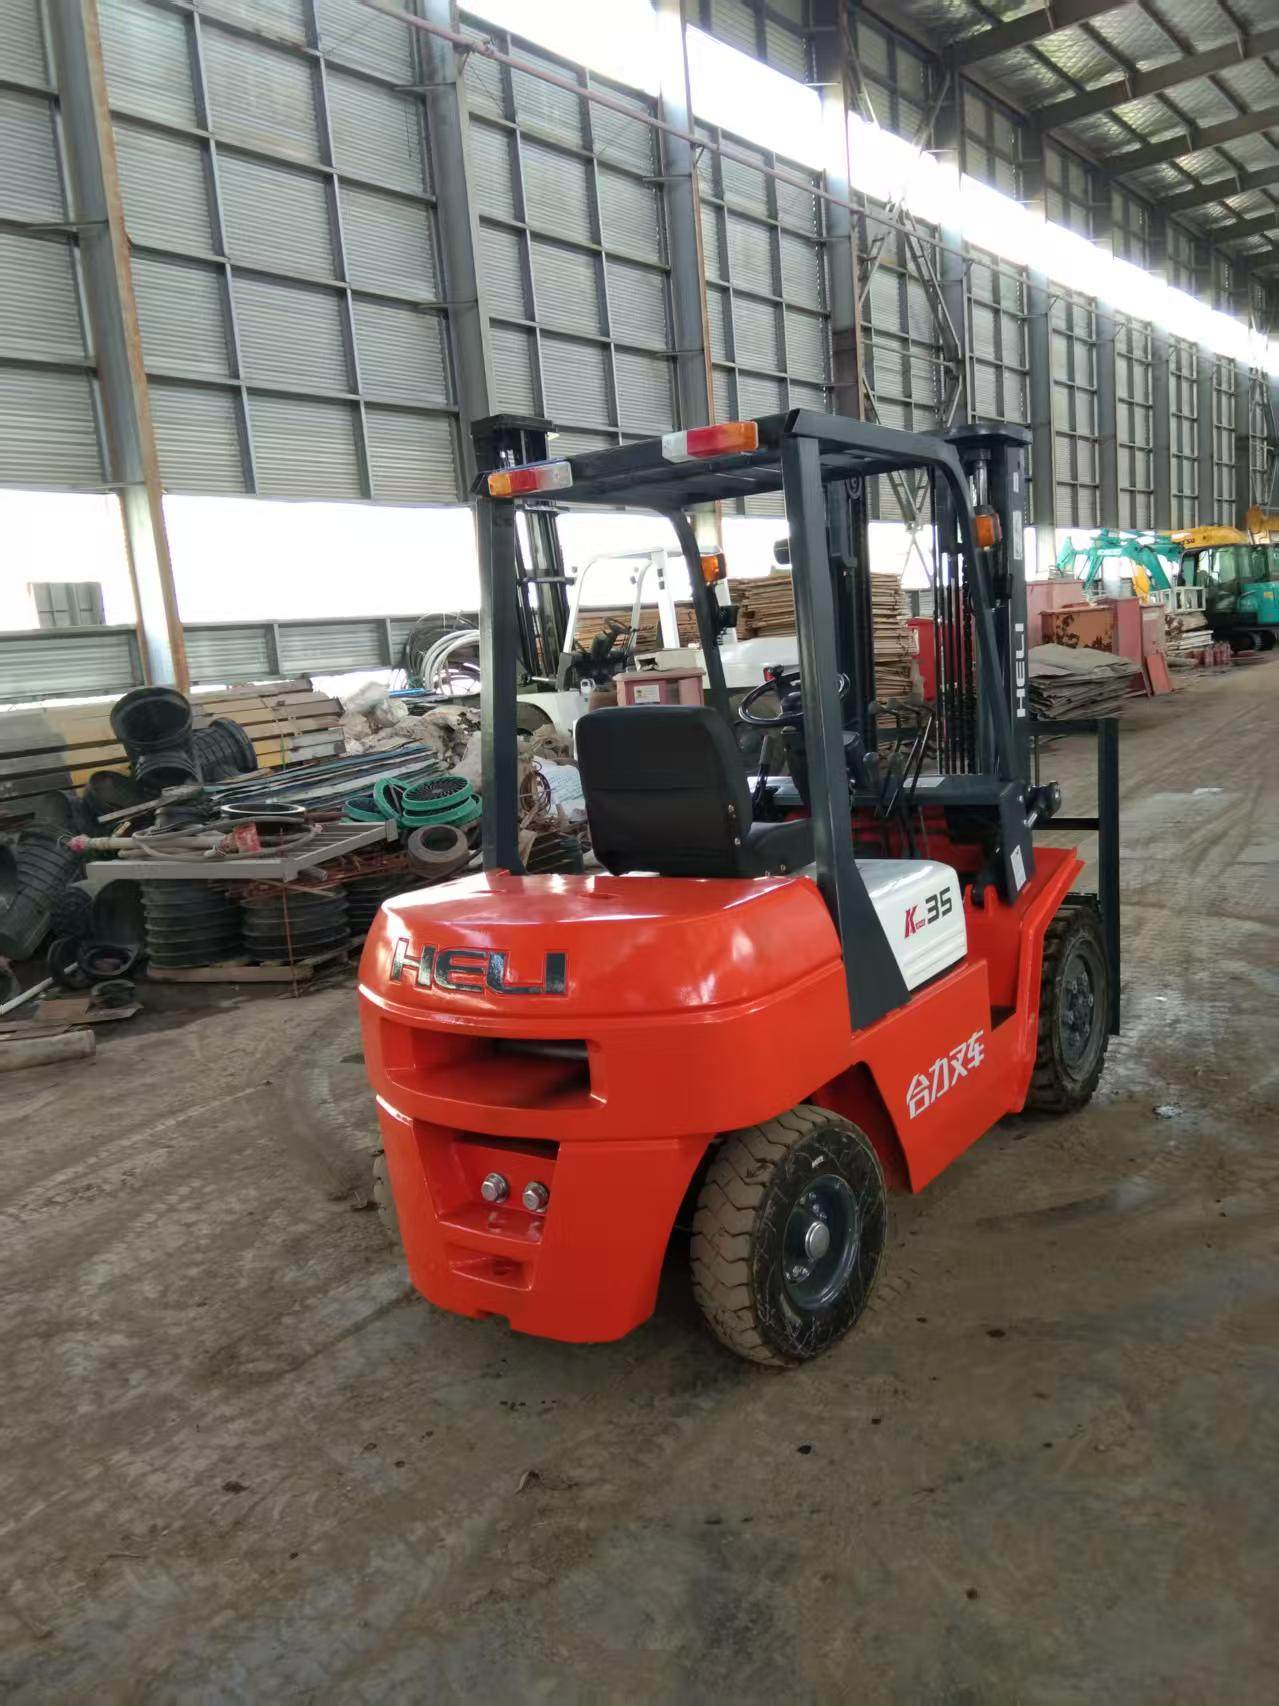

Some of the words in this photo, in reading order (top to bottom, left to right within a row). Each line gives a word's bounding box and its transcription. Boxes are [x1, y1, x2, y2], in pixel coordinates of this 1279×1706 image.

[1015, 623, 1026, 717] HELI
[389, 938, 567, 994] HELI
[906, 1029, 985, 1120] 合力叉车
